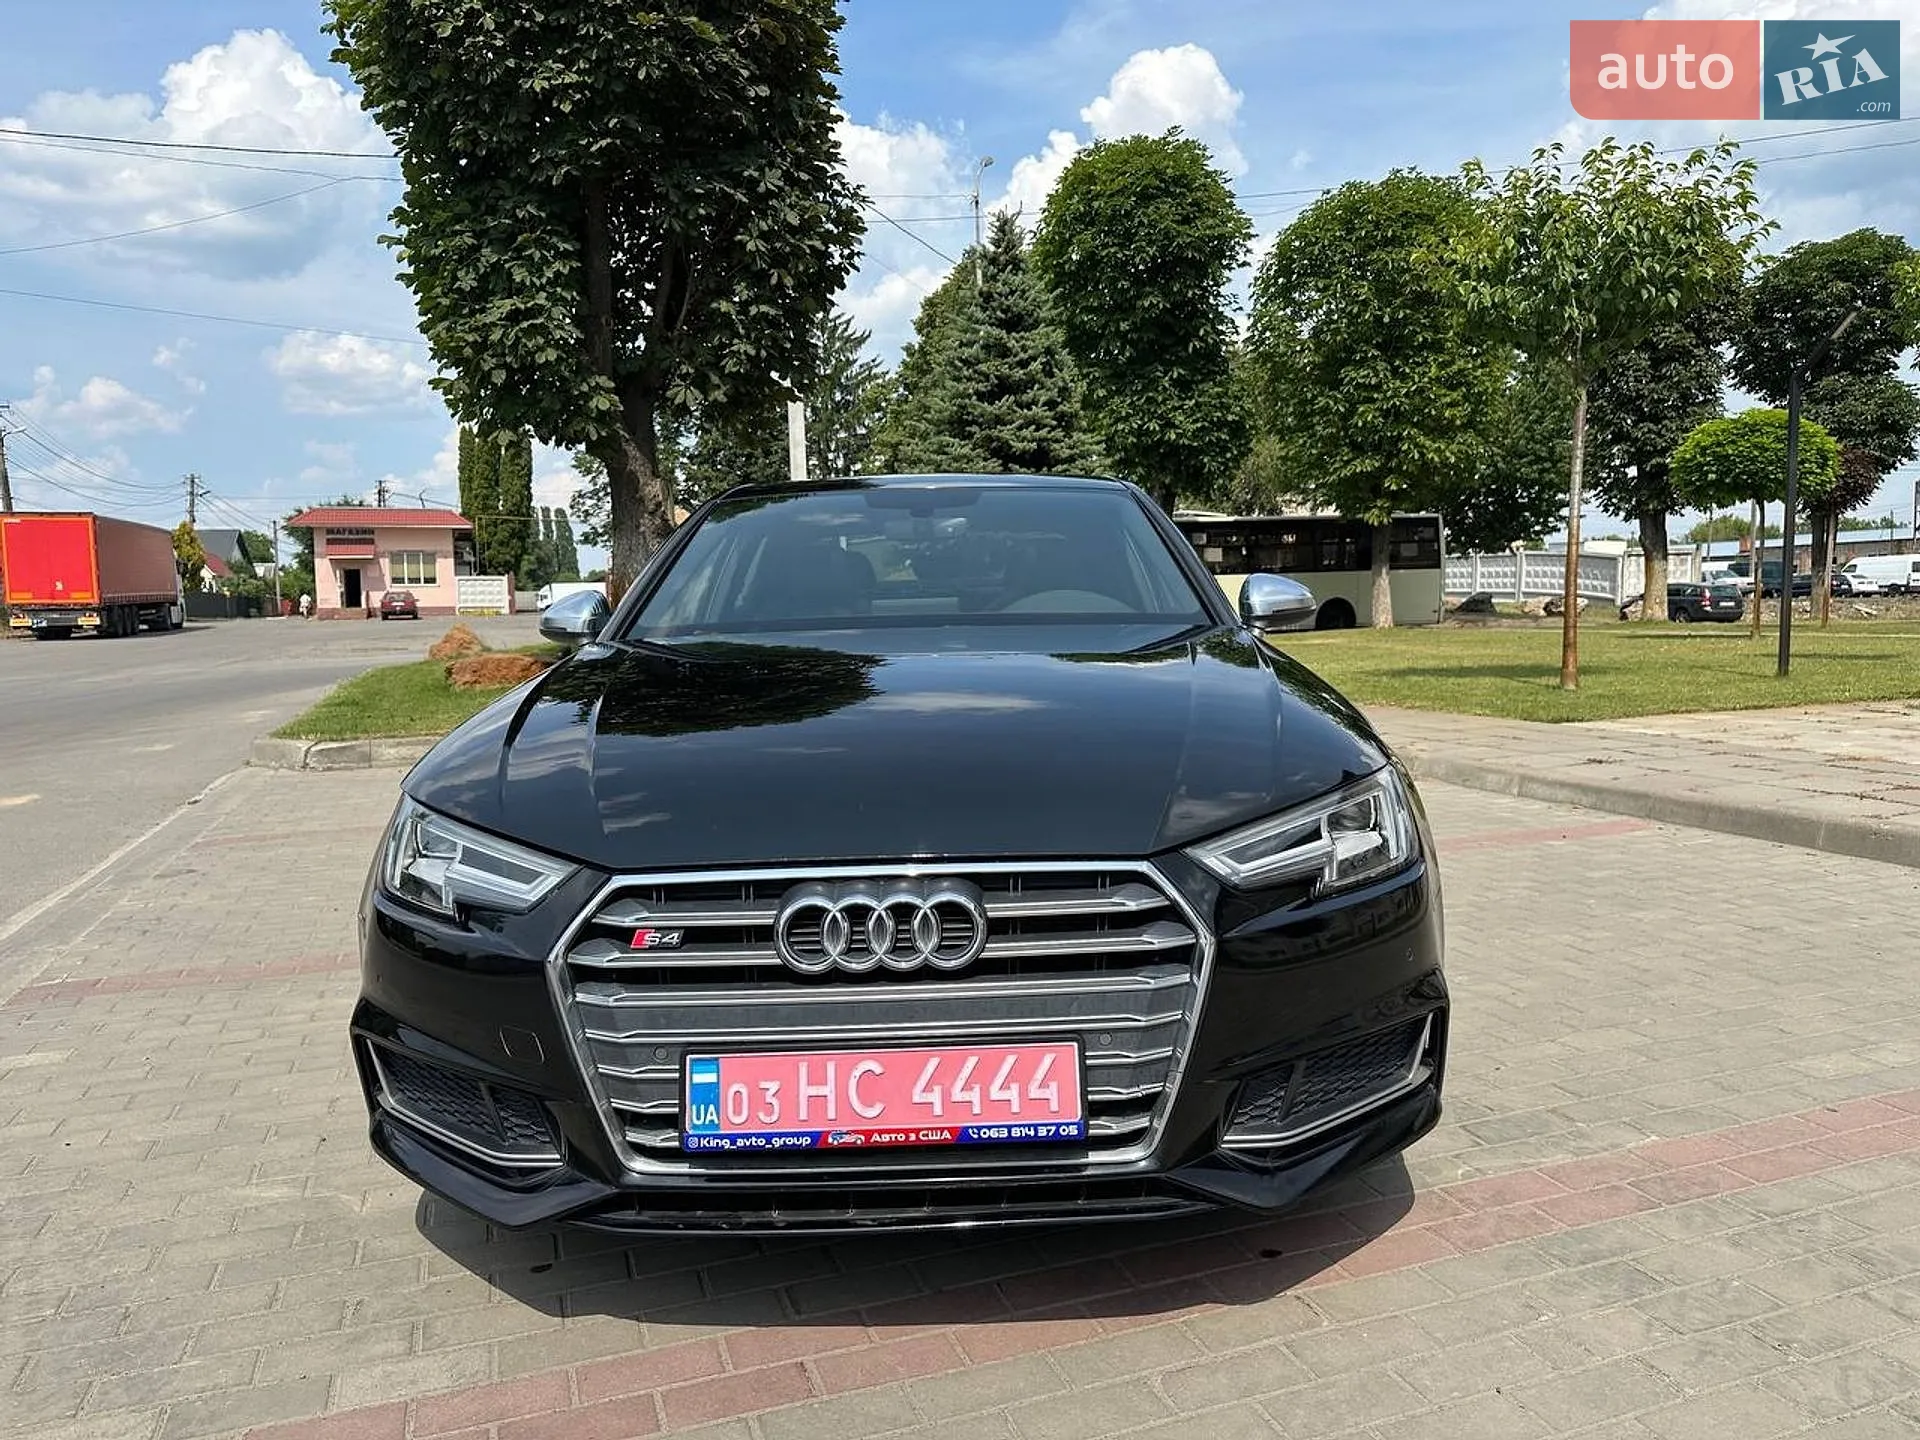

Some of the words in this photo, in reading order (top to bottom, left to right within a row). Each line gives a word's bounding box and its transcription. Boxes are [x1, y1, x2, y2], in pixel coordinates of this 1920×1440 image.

[644, 932, 680, 946] S4
[726, 1080, 781, 1126] 03
[798, 1059, 886, 1121] HC
[911, 1053, 1060, 1117] 4444
[692, 1104, 719, 1125] UA
[870, 1130, 905, 1143] Авто
[919, 1128, 953, 1141] США
[979, 1129, 1008, 1138] 063
[1011, 1127, 1035, 1137] 814
[1037, 1126, 1057, 1136] 37
[700, 1135, 812, 1149] King_avto_group
